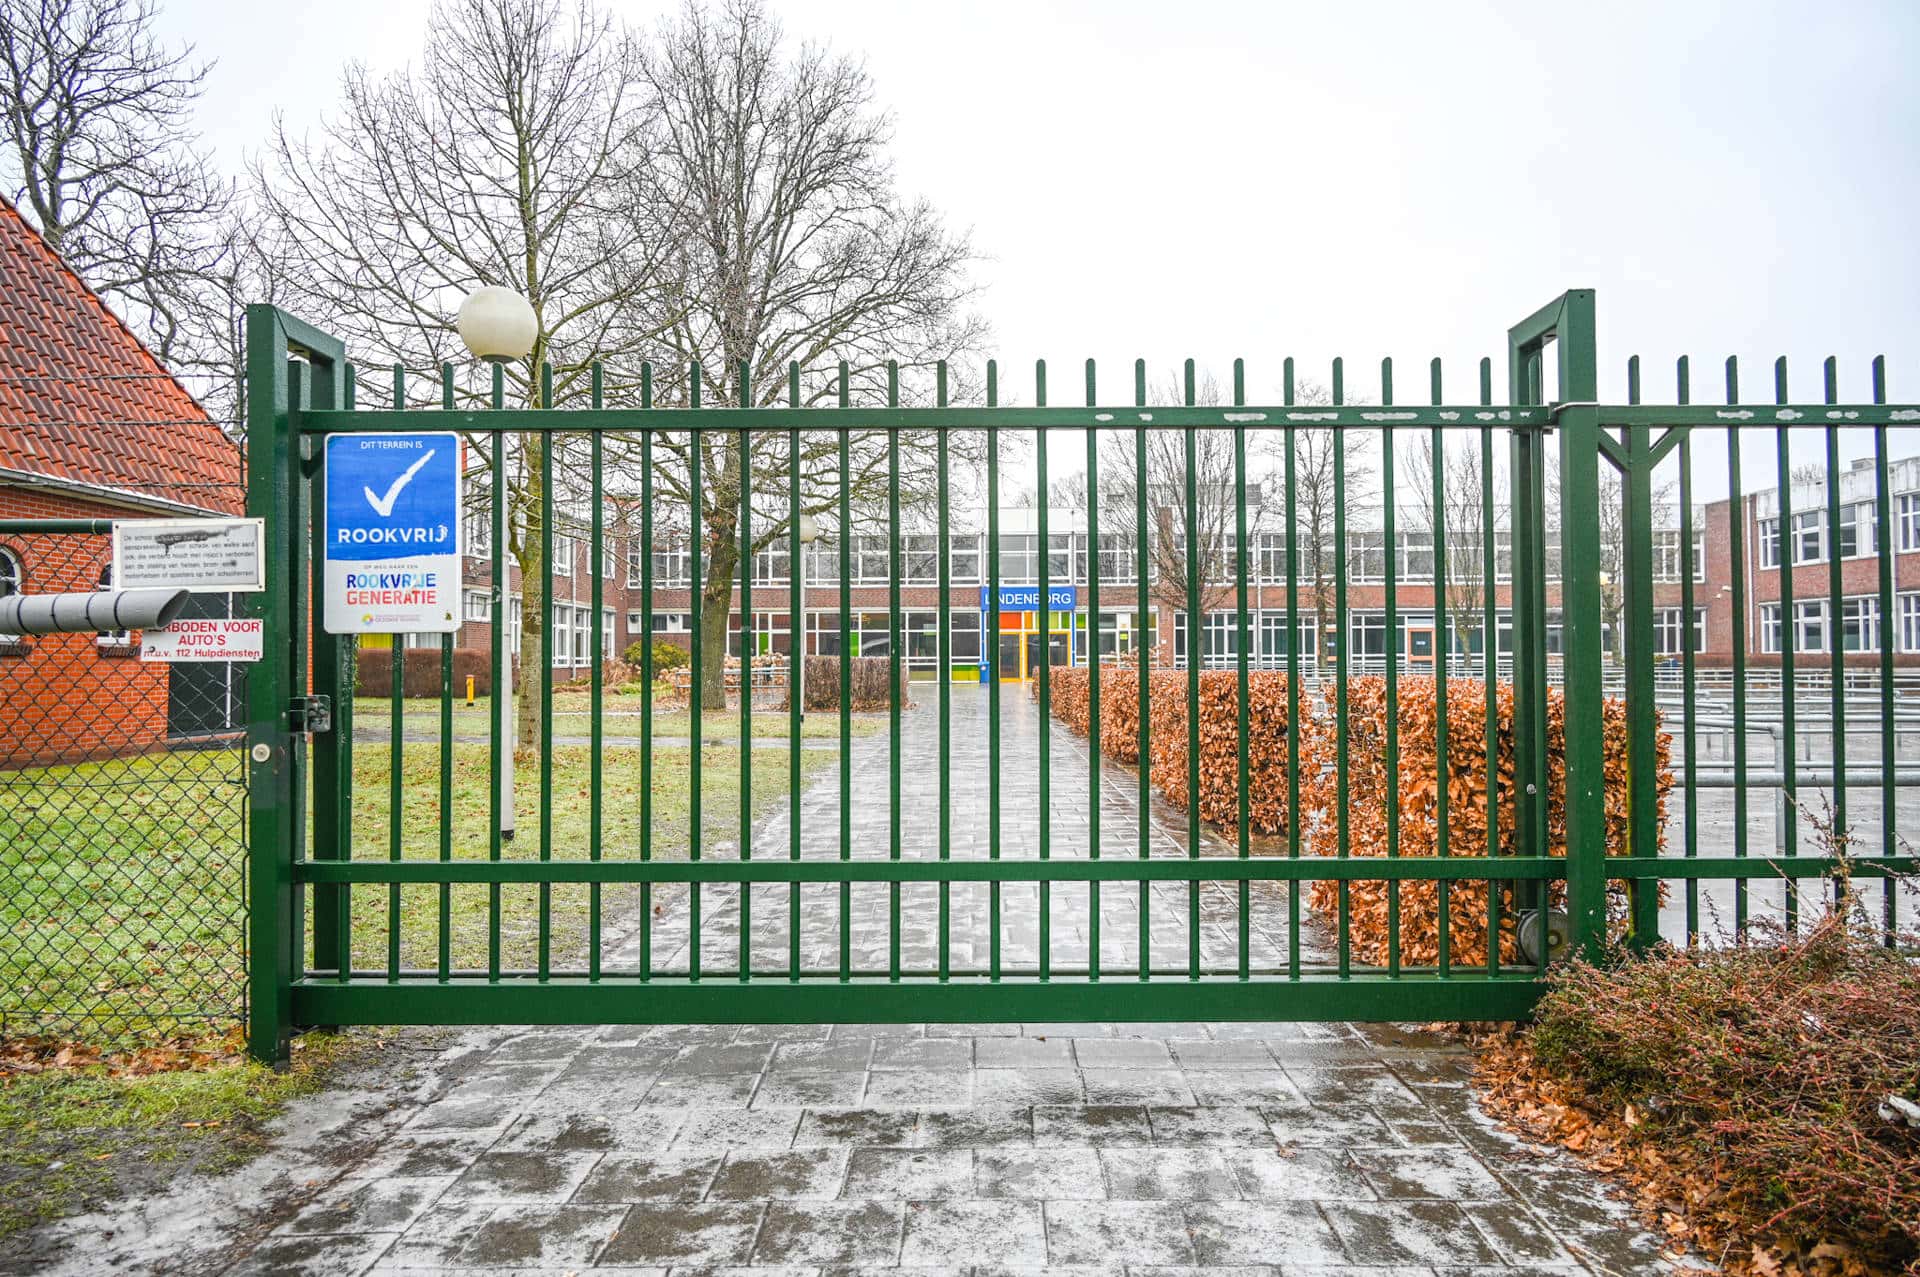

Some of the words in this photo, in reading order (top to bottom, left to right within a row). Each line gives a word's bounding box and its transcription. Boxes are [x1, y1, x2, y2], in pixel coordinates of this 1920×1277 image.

[360, 441, 375, 449] DIT
[378, 441, 413, 449] TERREIN
[416, 441, 423, 449] IS
[338, 525, 448, 543] ROOKVRIJ
[347, 590, 436, 605] GENERATIE
[148, 621, 217, 633] RBODEN
[223, 621, 260, 633] VOOR
[178, 634, 226, 646] AUTO'S
[144, 649, 171, 657] m.u.v.
[176, 649, 191, 657] 112
[194, 648, 260, 659] Hulpdiensten
